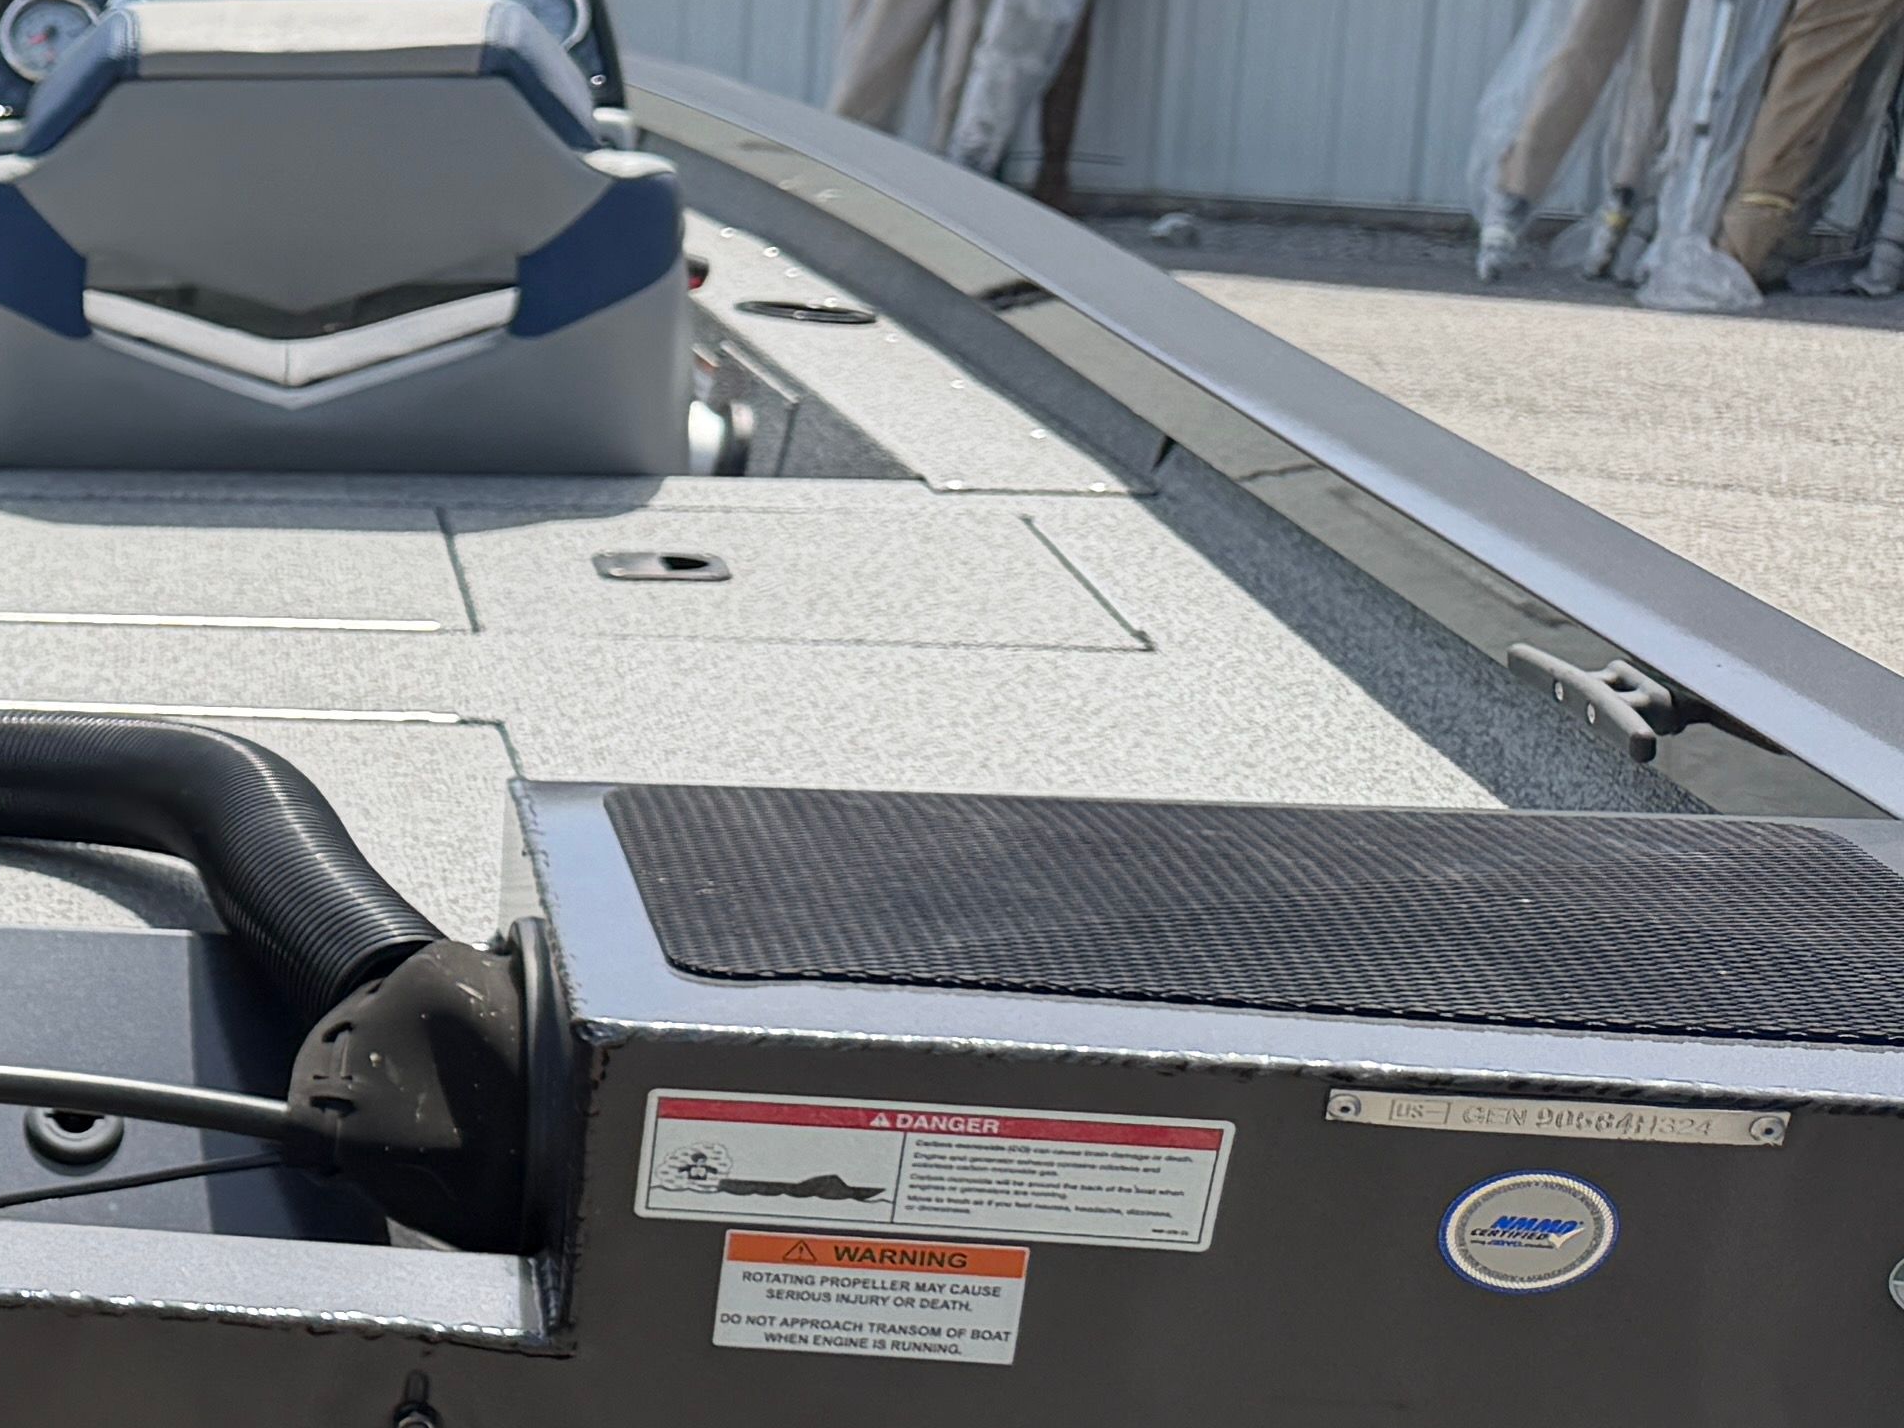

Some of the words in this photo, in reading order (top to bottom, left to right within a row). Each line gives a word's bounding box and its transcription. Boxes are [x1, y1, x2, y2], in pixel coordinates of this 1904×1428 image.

[895, 1112, 1000, 1136] DANGER
[1470, 1227, 1550, 1240] CERTIFIED
[834, 1245, 968, 1268] WARNING
[742, 1271, 815, 1285] ROTATING
[820, 1276, 910, 1292] PROPELLER
[915, 1282, 946, 1295] MAY
[949, 1284, 1001, 1297] CAUSE
[766, 1288, 831, 1302] SERIOUS
[836, 1293, 890, 1306] INJURY
[893, 1296, 914, 1308] OR
[720, 1313, 741, 1324] DO
[745, 1315, 776, 1327] NOT
[780, 1317, 863, 1332] APPROACH
[868, 1322, 941, 1337] TRANSOM
[946, 1327, 966, 1339] OF
[971, 1329, 1011, 1342] BOAT
[764, 1332, 808, 1344] WHEN
[813, 1335, 867, 1349] ENGINE
[872, 1339, 886, 1350] IS
